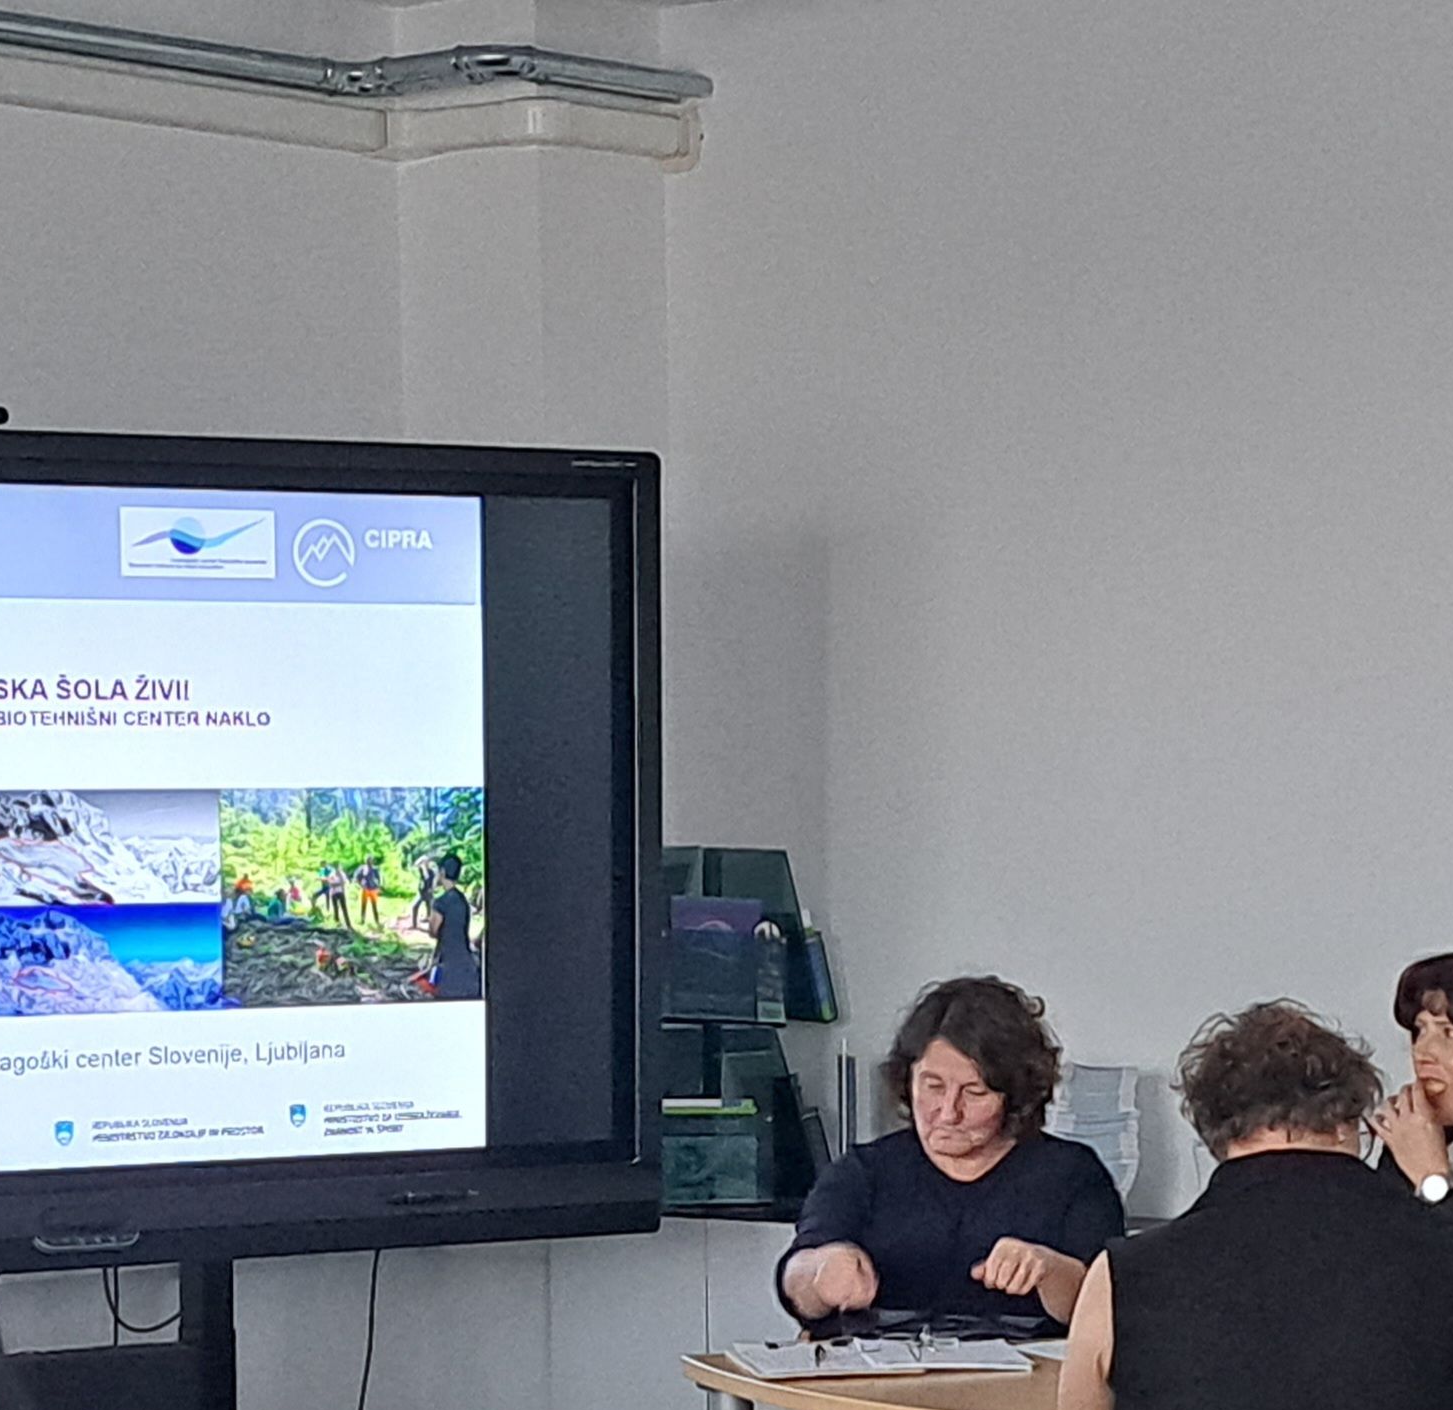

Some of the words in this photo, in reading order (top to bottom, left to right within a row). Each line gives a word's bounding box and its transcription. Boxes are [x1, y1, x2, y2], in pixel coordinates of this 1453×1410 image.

[363, 528, 434, 550] CIPRA
[55, 673, 129, 701] ŠOLA
[123, 710, 200, 727] CENTER
[205, 710, 272, 727] NAKLO
[75, 1048, 142, 1069] center
[148, 1043, 249, 1070] Slovenije,
[255, 1040, 346, 1066] Ljubljana
